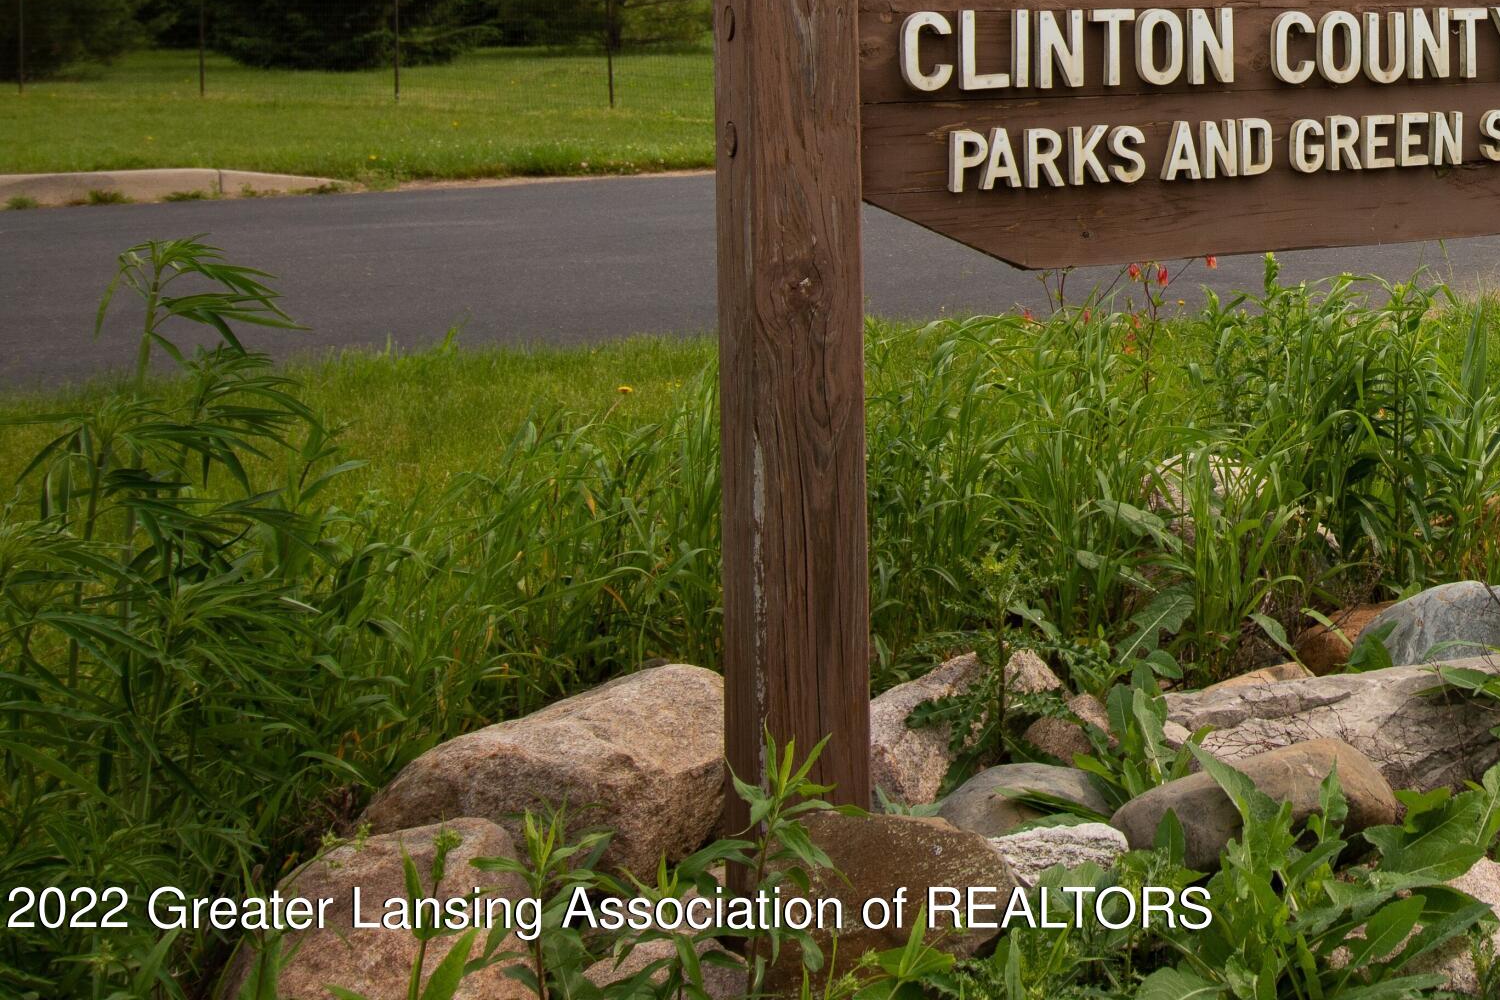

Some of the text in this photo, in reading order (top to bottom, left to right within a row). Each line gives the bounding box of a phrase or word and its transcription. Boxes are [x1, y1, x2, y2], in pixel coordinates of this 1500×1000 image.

[900, 8, 1234, 92] CLINTON
[948, 124, 1146, 193] PARKS
[1160, 117, 1273, 181] AND
[1289, 110, 1463, 173] GREEN
